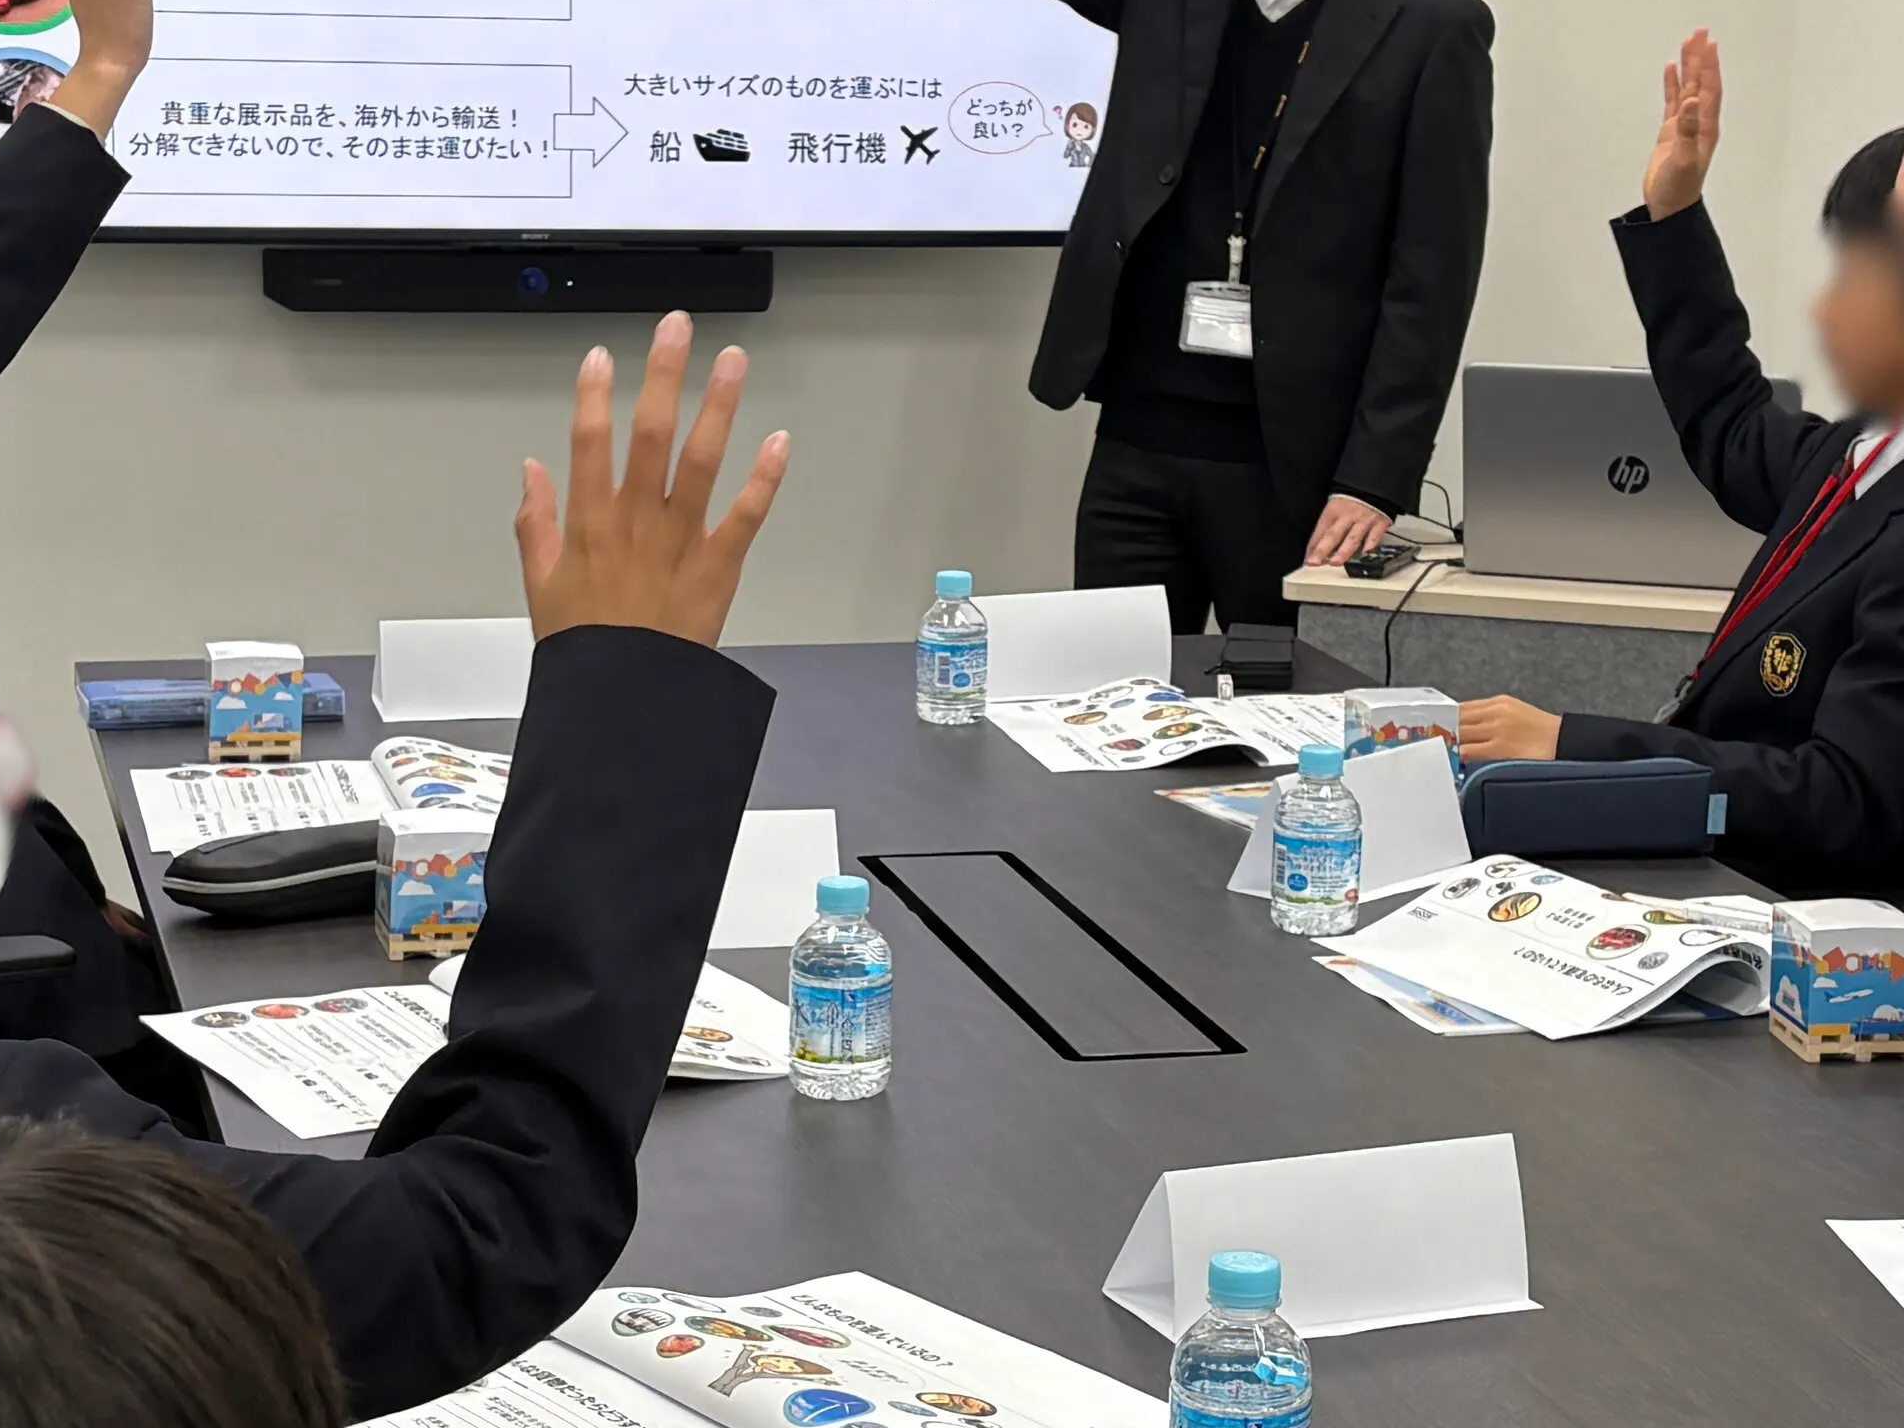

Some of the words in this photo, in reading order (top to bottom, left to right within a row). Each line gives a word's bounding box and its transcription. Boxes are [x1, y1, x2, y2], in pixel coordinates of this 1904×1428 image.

[623, 72, 943, 100] 大きいサイズのものを運ぶには
[159, 101, 518, 130] 貴重な展示品を、海外から輸送！
[965, 98, 1034, 119] どっちが
[972, 119, 1025, 140] 良い？
[129, 133, 551, 161] 分解できないので、そのまま運びたい！
[649, 130, 682, 164] 船
[787, 133, 887, 166] 飛行機
[1611, 456, 1646, 494] hp
